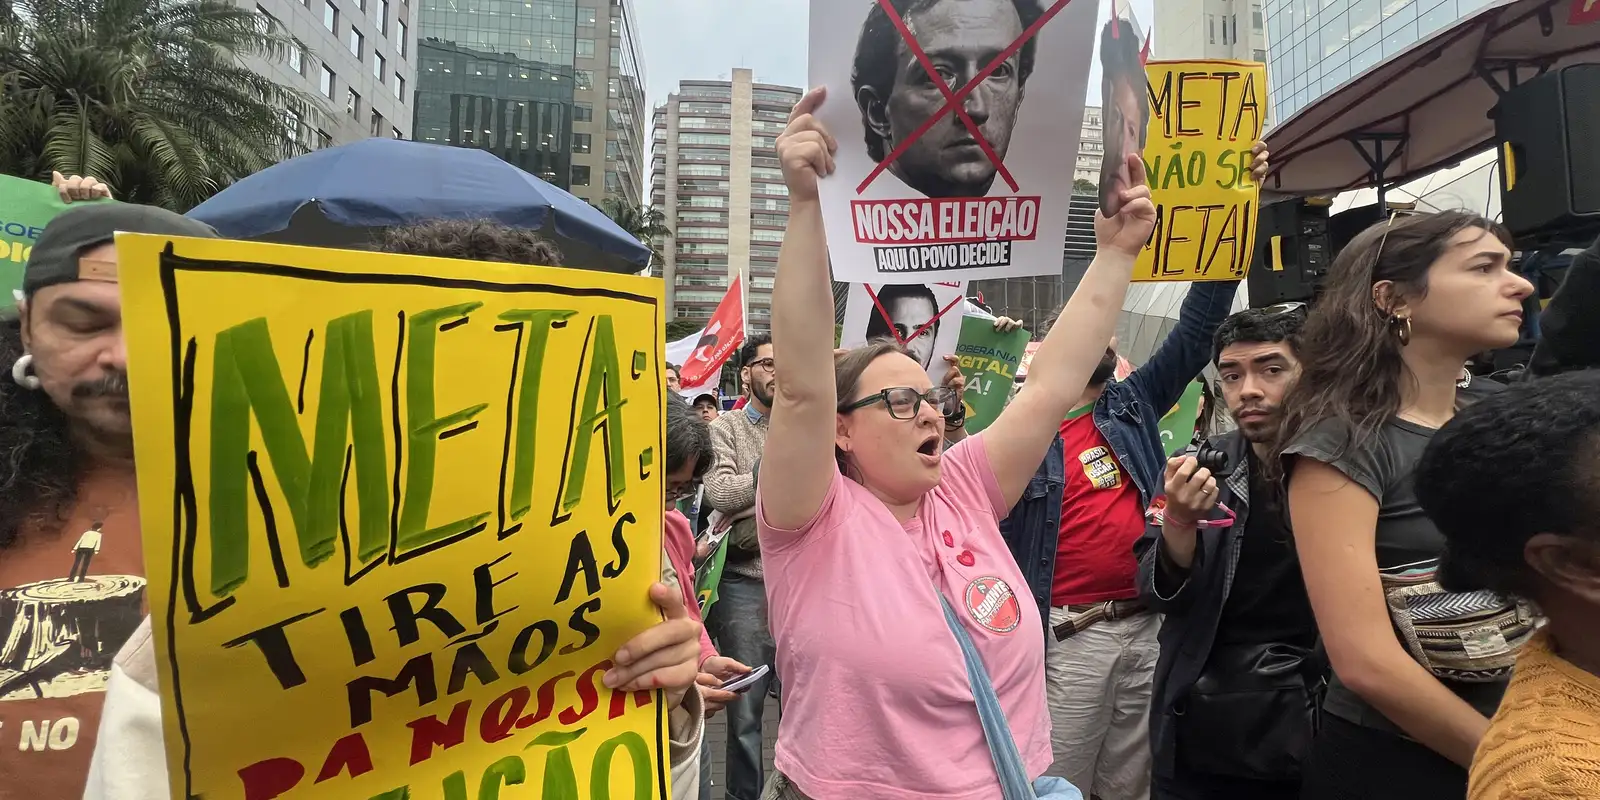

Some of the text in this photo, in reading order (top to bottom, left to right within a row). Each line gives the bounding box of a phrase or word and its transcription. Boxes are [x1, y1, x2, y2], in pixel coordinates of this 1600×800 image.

[1147, 71, 1258, 141] META
[1216, 149, 1255, 190] SE
[854, 197, 1036, 241] NOSSA ELEIÇÃO
[878, 241, 1008, 271] AQUI O POVO DECIDE
[959, 354, 1013, 379] GITAL
[963, 372, 992, 396] Á!
[205, 302, 653, 602] META:
[221, 511, 635, 689] TIRE AS
[345, 597, 601, 729] MÃOS
[19, 717, 79, 751] NO
[237, 732, 374, 800] DA
